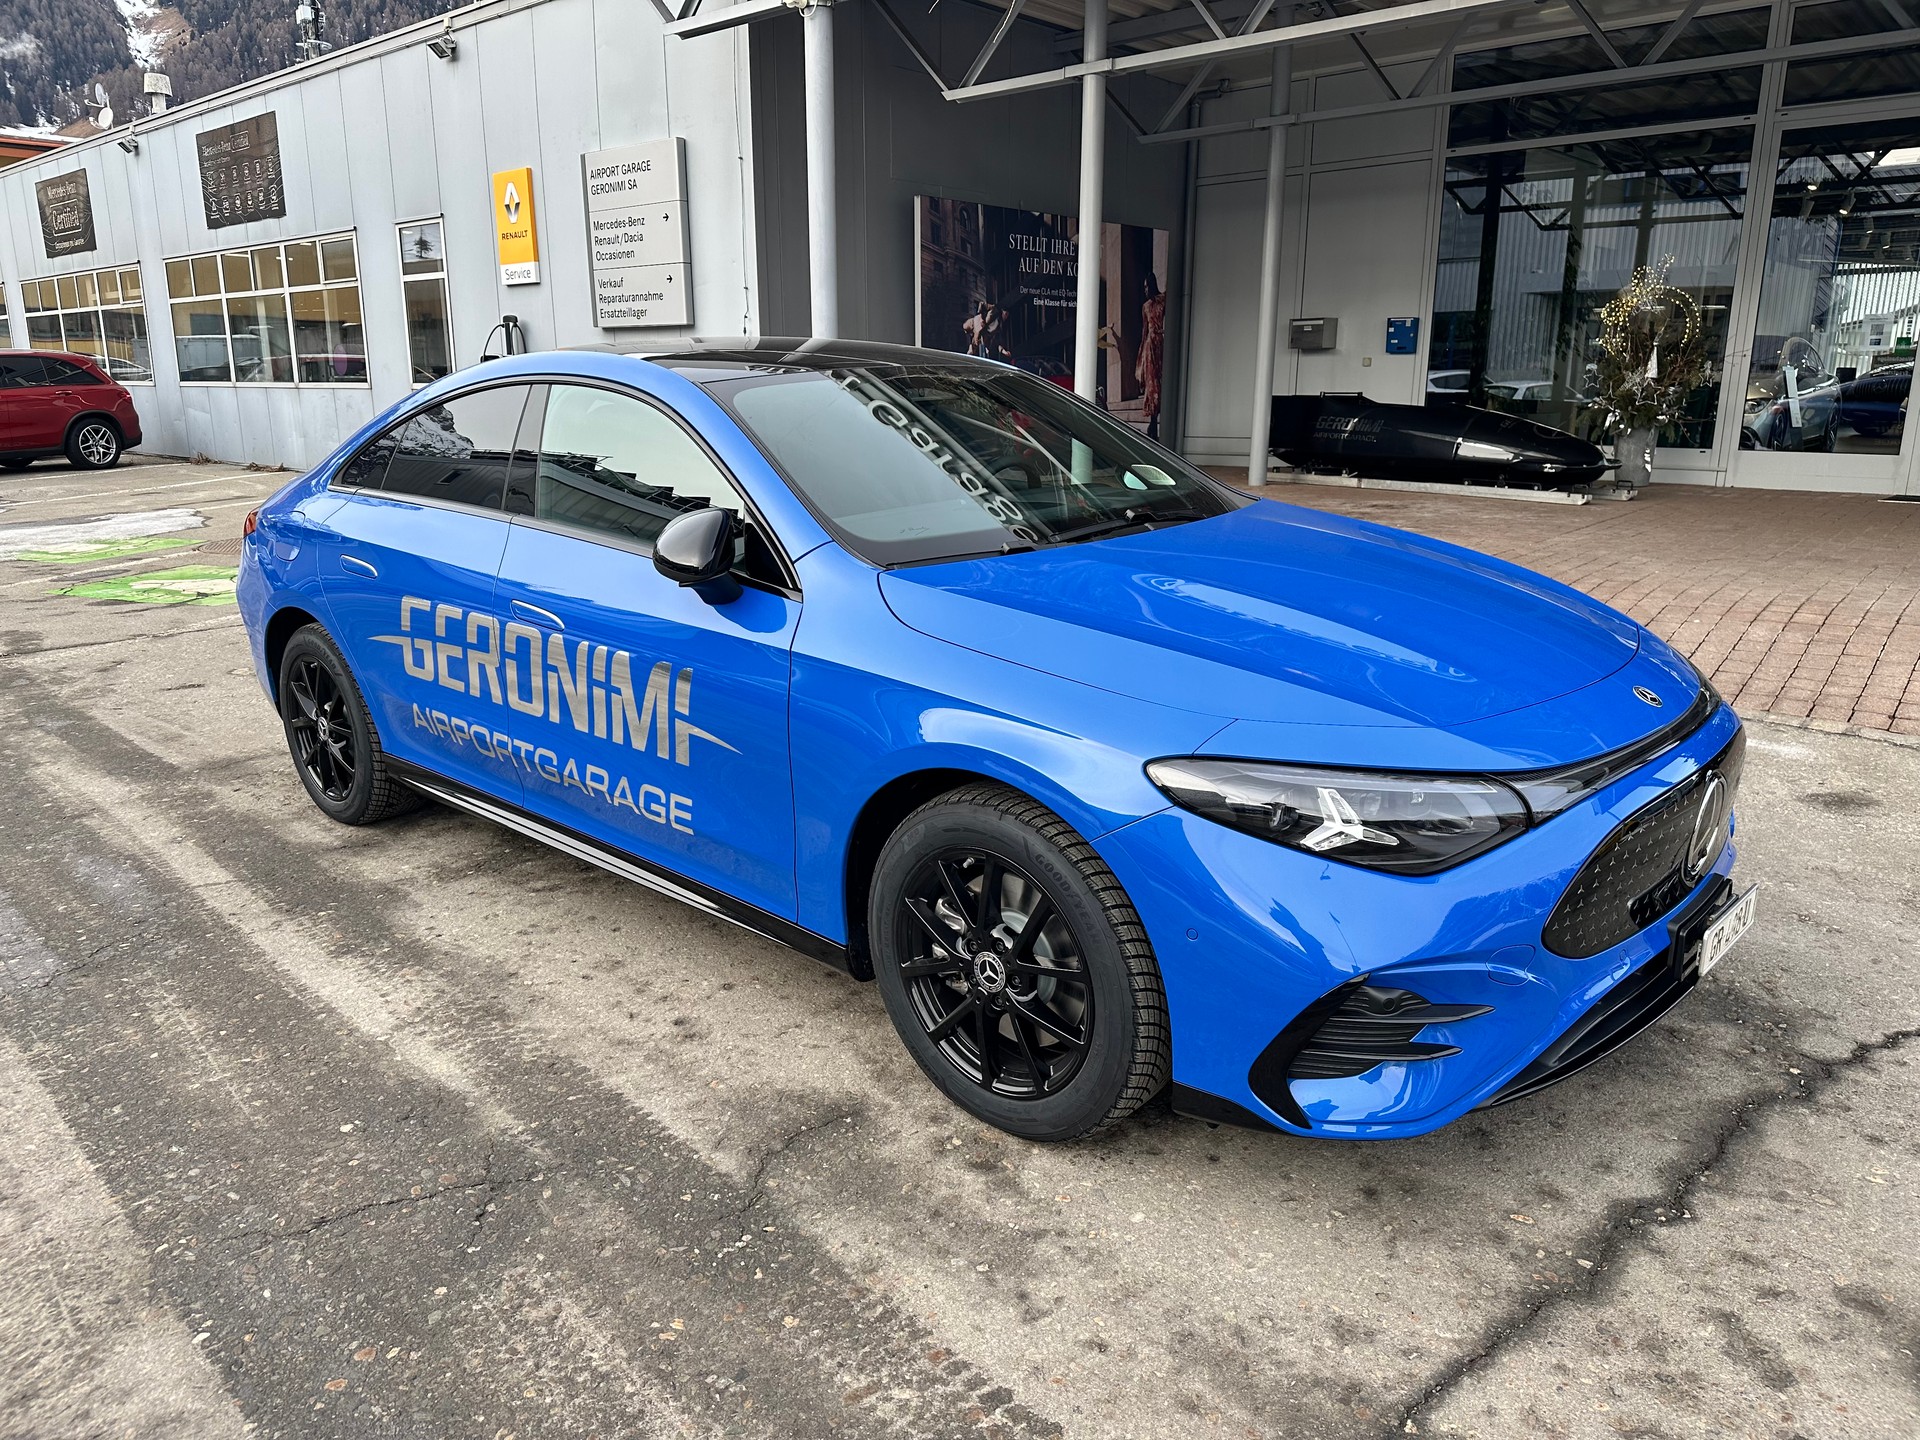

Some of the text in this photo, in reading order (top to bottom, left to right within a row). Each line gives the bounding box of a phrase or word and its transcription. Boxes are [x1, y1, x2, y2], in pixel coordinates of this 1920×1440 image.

[590, 160, 651, 180] AIRPORT GARAGE
[591, 178, 638, 195] GERONIMI SA
[52, 206, 80, 230] Certified
[594, 216, 645, 231] Mercedes-Benz
[502, 230, 528, 240] RENAULT
[594, 231, 644, 246] Renault/Dacia
[1009, 234, 1076, 256] STELLT IHRE
[596, 249, 635, 261] Occasionen
[1018, 257, 1039, 273] AUF
[1043, 259, 1063, 275] DEN
[505, 268, 531, 280] Service
[598, 277, 624, 288] Verkauf
[1020, 286, 1028, 294] Der
[1041, 287, 1050, 295] CLA
[599, 291, 664, 306] Reparaturannahme
[1045, 298, 1060, 306] Klasse
[600, 307, 647, 320] Ersatzteillager
[400, 595, 695, 767] GERONIMI
[411, 702, 695, 836] AIRPORTGARAGE
